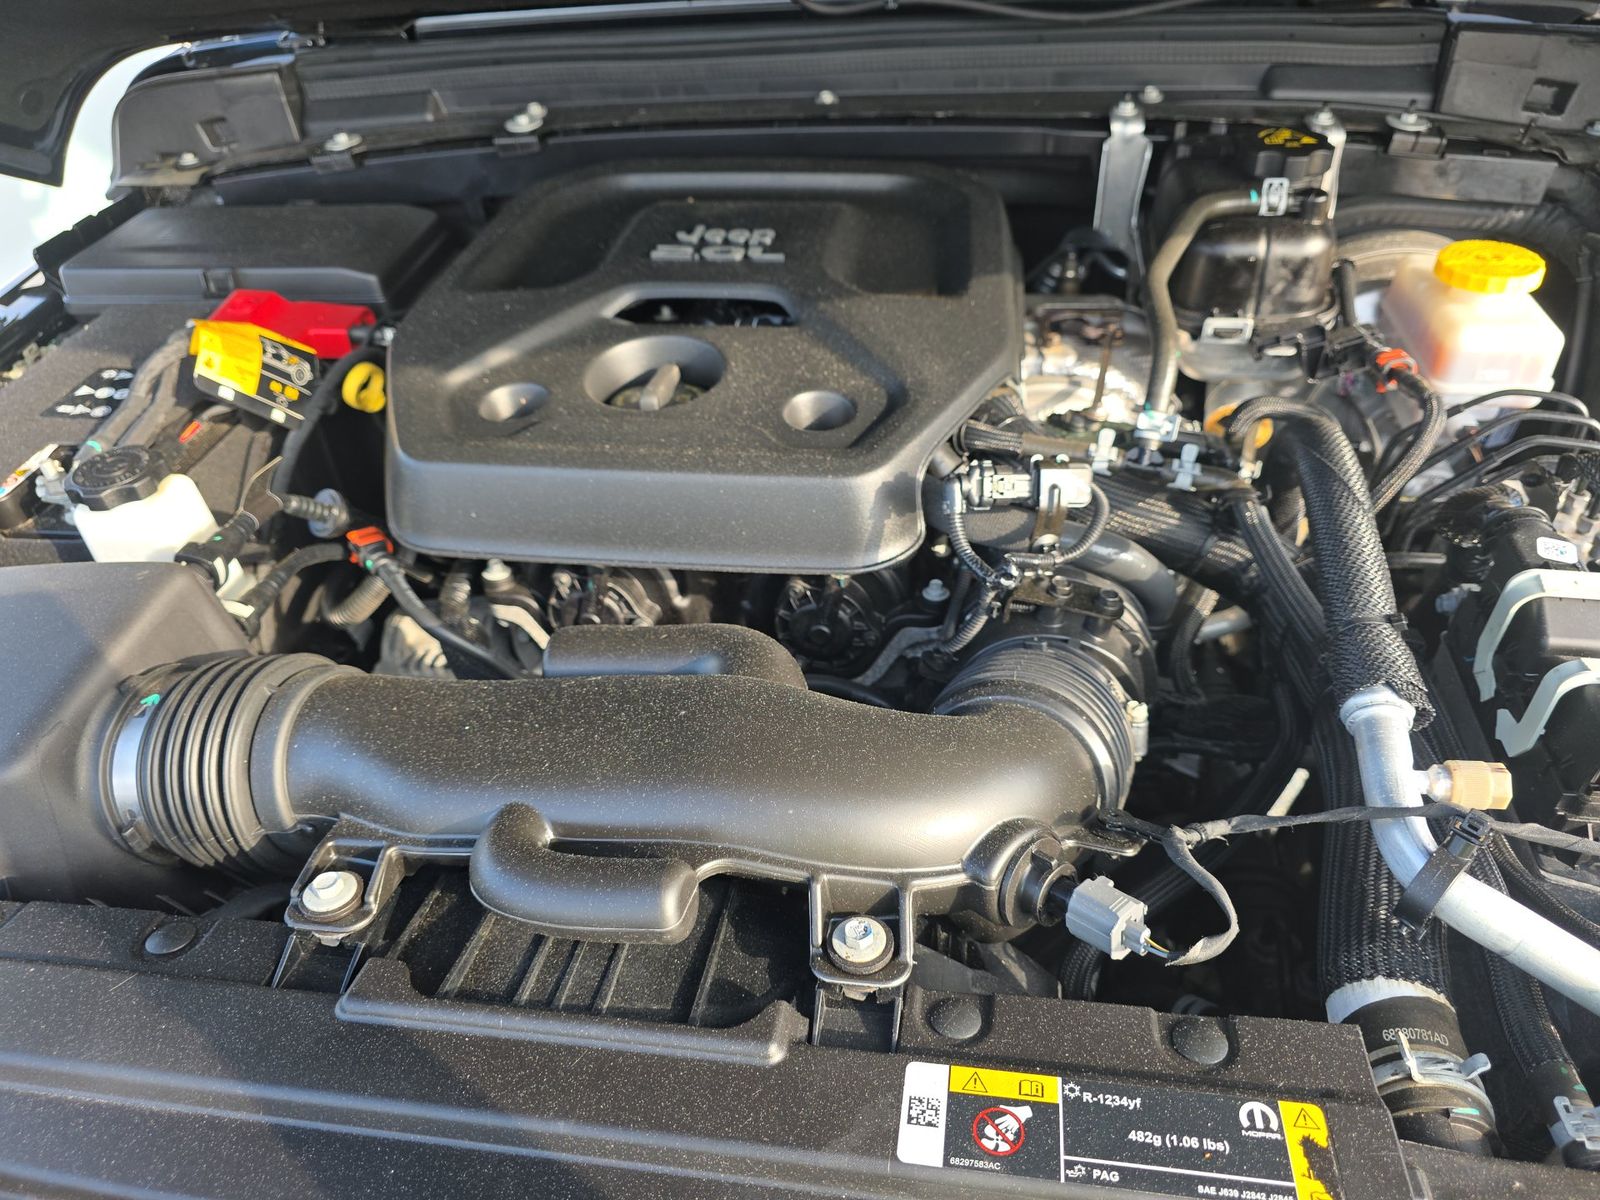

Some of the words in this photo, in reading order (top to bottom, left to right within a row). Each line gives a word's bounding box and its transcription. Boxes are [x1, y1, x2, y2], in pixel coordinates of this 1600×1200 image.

[650, 244, 786, 262] 2.0L
[1082, 1092, 1142, 1110] R-1234yf
[1127, 1130, 1162, 1147] 482g
[1165, 1133, 1200, 1149] (1.06
[1202, 1138, 1230, 1155] lbs)
[949, 1156, 1001, 1170] 68297583AC
[1092, 1168, 1120, 1182] PAG
[1197, 1185, 1217, 1195] SAE
[1218, 1187, 1239, 1198] J639
[1240, 1190, 1267, 1200] J2842
